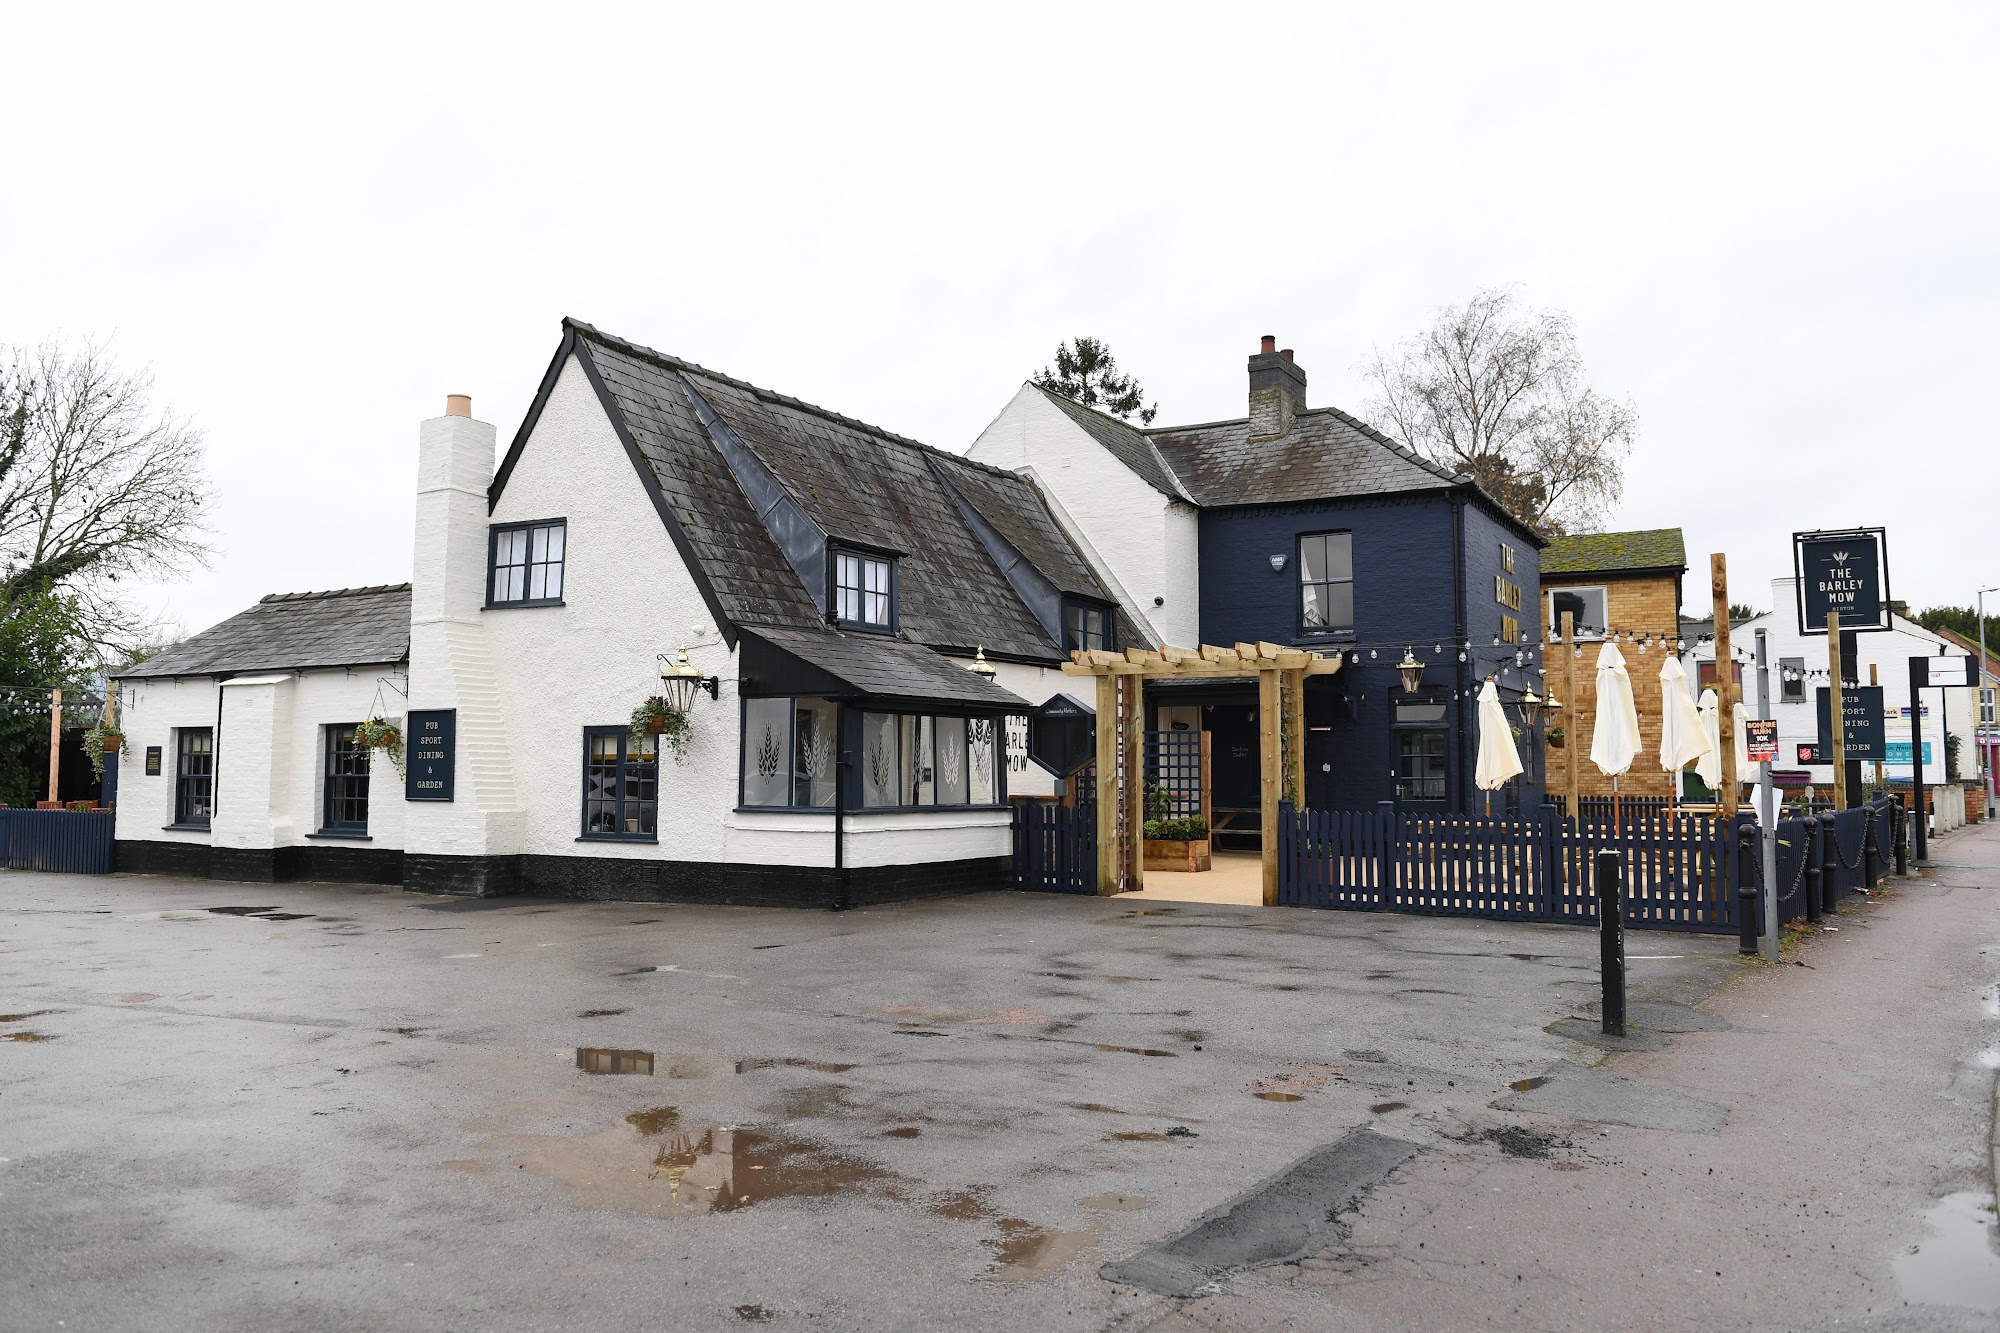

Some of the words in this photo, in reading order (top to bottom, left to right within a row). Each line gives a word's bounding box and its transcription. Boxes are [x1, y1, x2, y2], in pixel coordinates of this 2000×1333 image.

[1500, 543, 1515, 574] THE
[1829, 568, 1852, 579] THE
[1819, 579, 1863, 592] BARLEY
[1496, 575, 1521, 611] BARLEY
[1829, 592, 1854, 603] MOW
[1502, 614, 1518, 645] MOW
[425, 722, 439, 730] PUB
[420, 736, 442, 744] SPORT
[1005, 732, 1028, 750] ARLE
[416, 780, 444, 789] GARDEN
